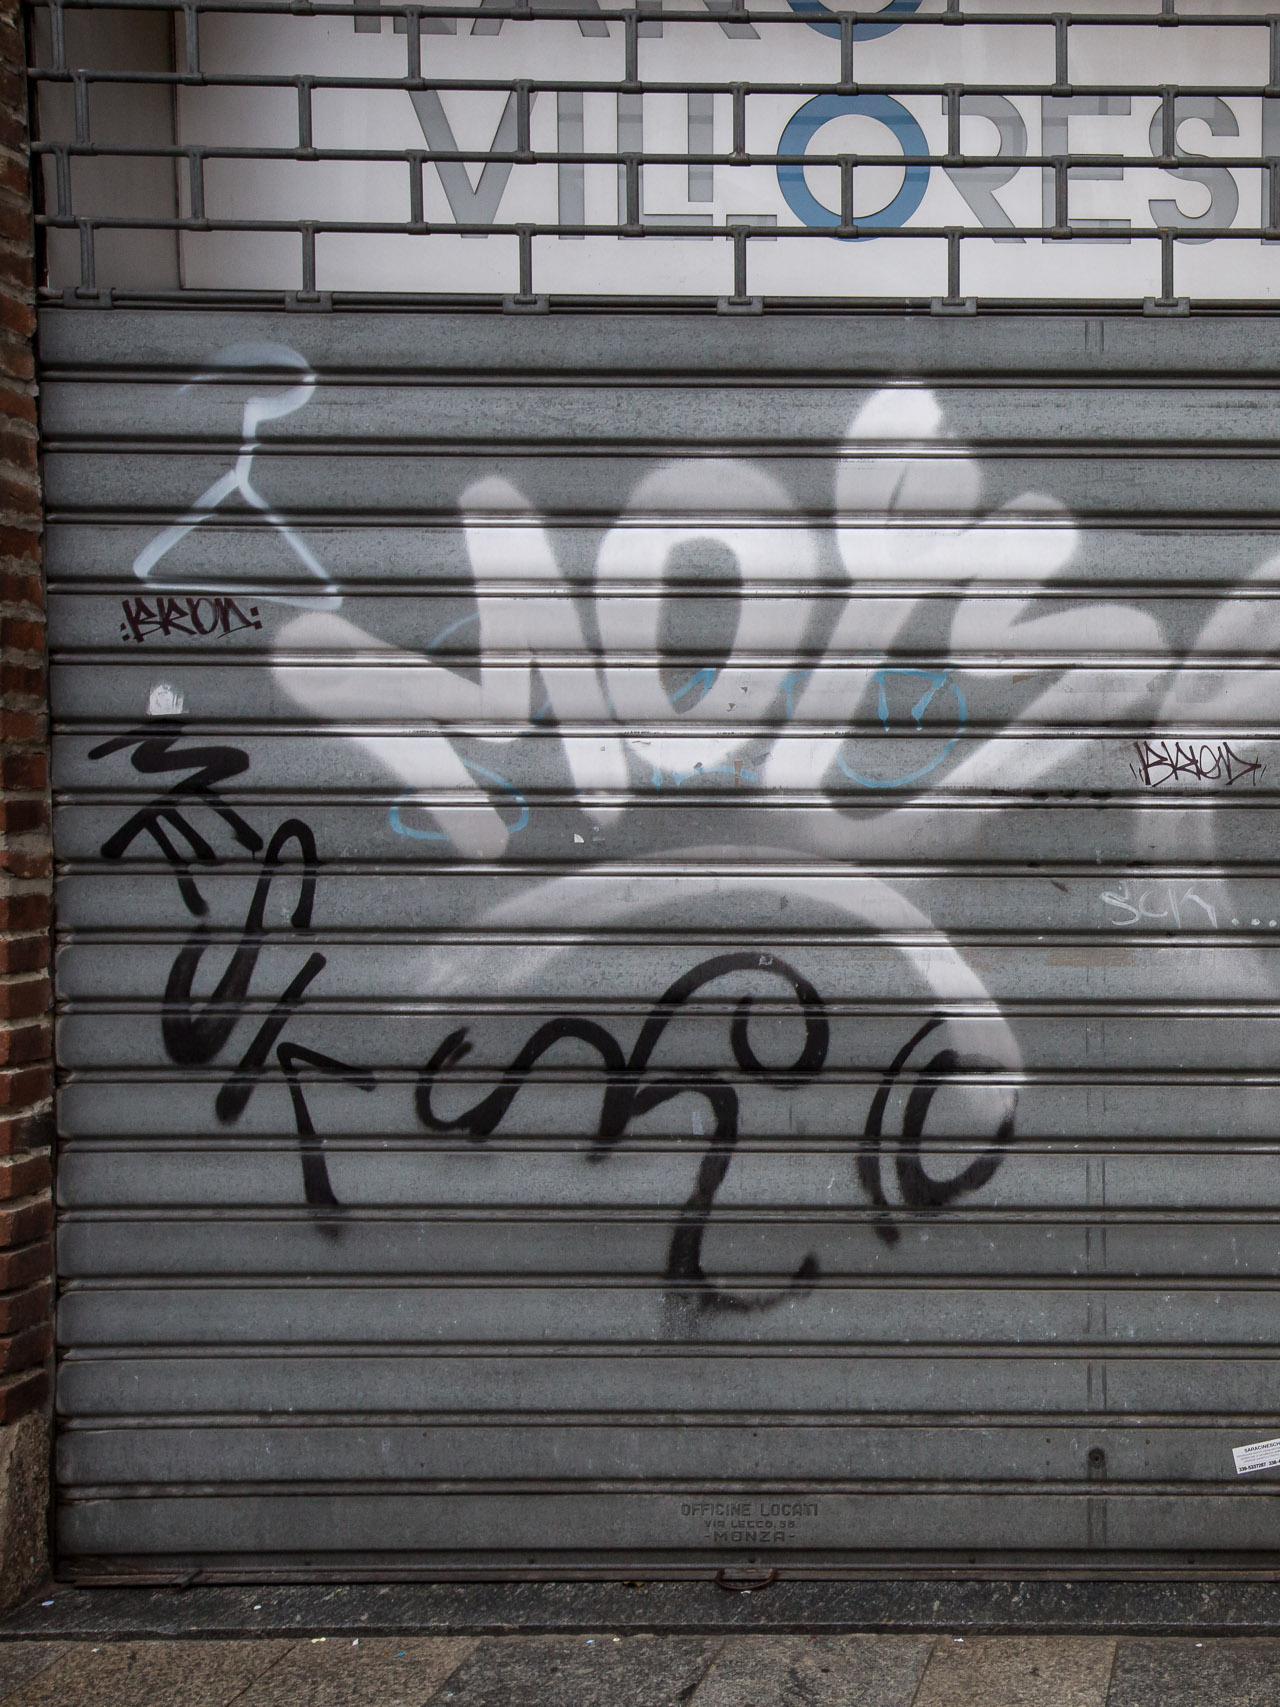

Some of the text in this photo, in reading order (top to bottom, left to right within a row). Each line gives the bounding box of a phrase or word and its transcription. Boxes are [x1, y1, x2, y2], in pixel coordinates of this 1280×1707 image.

[681, 1503, 819, 1517] OFFICINE LOCATI
[705, 1520, 725, 1528] VIA
